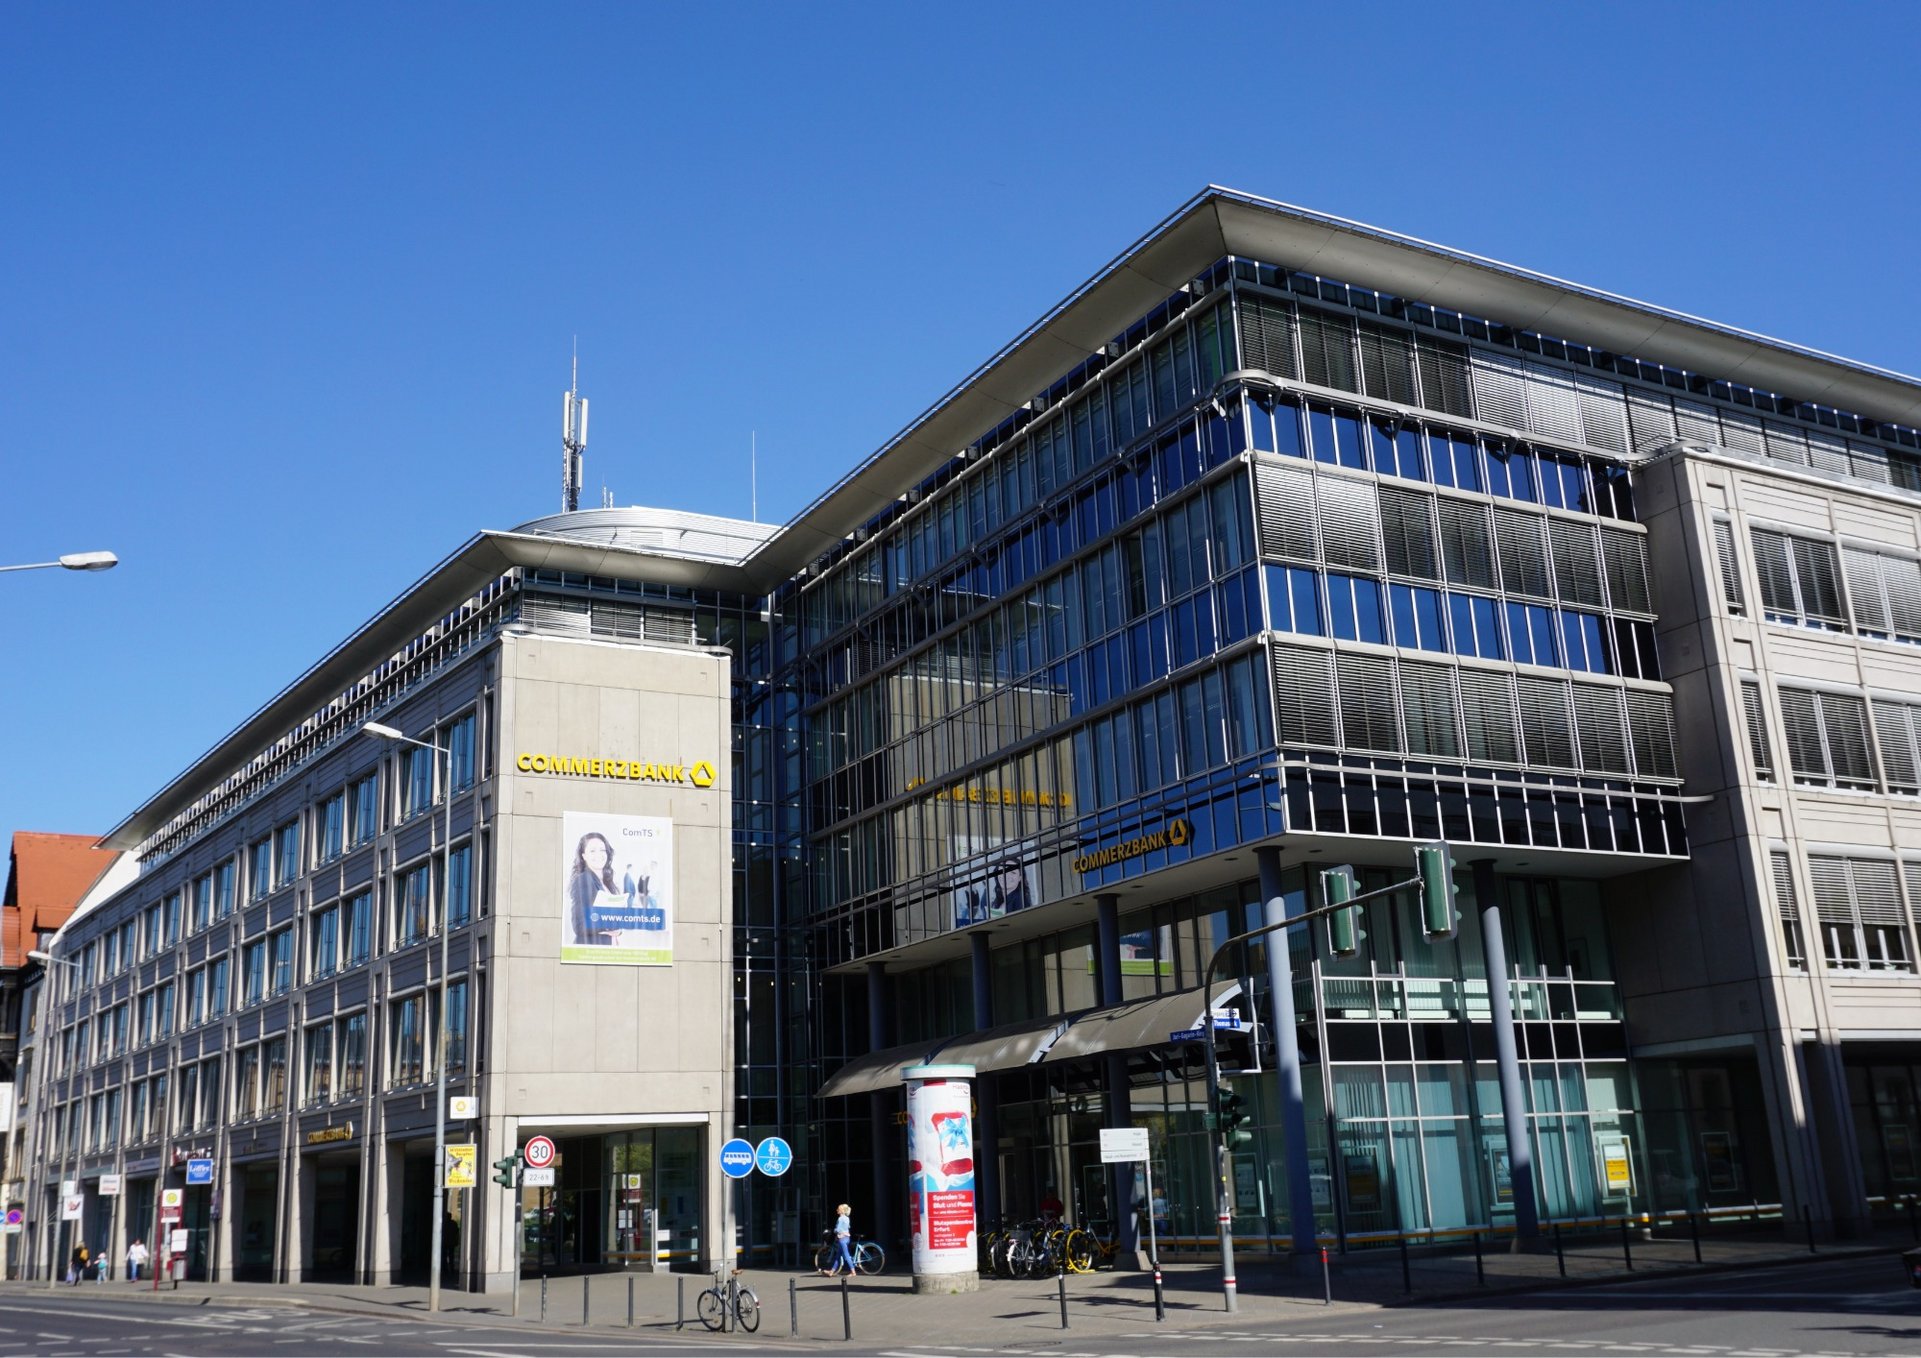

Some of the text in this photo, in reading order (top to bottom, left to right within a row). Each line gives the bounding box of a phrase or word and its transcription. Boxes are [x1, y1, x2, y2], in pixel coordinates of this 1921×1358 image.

[517, 753, 684, 782] COMMERZBANK
[622, 828, 653, 837] ComTS
[1073, 830, 1167, 873] COMMERZBANK
[601, 915, 661, 923] www.comts.de
[532, 1145, 548, 1159] 30
